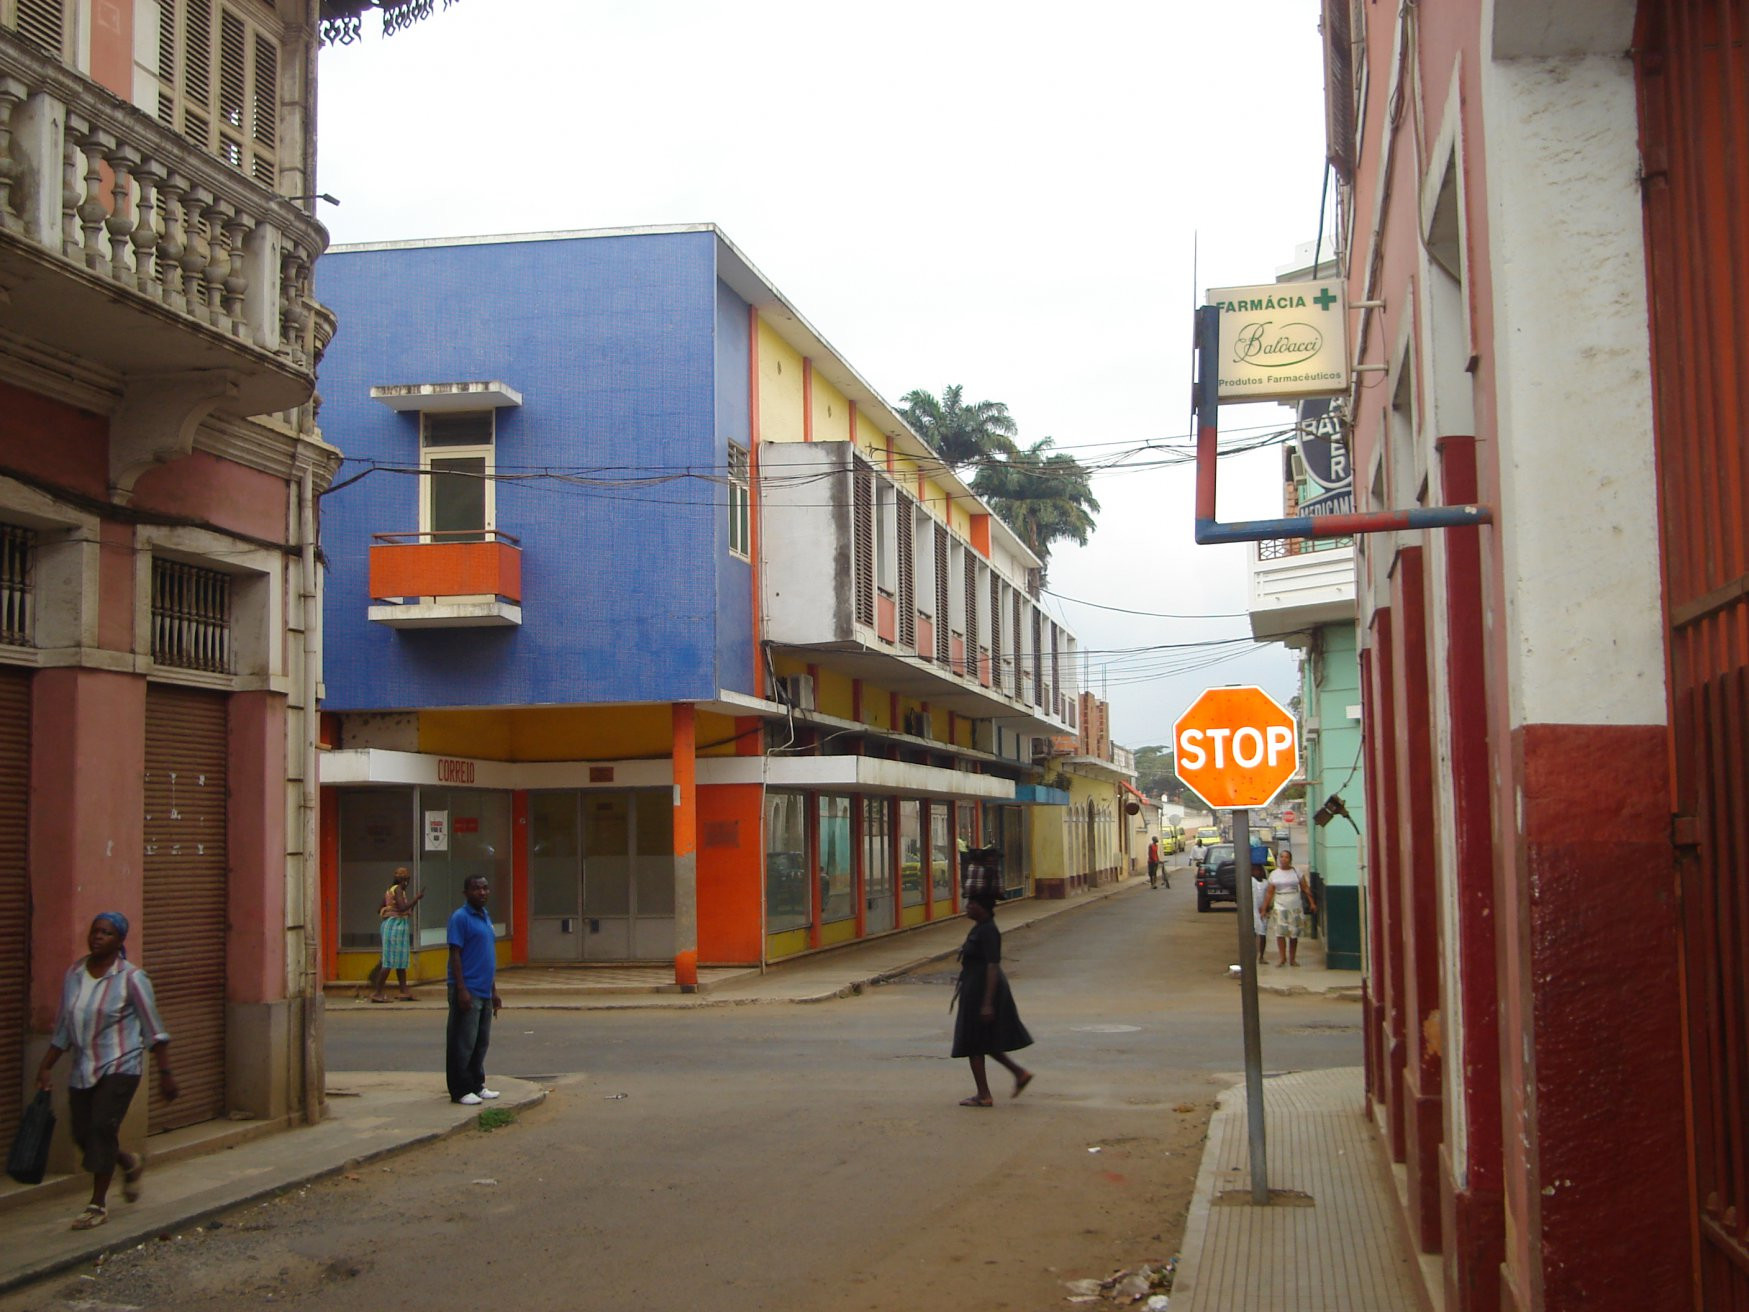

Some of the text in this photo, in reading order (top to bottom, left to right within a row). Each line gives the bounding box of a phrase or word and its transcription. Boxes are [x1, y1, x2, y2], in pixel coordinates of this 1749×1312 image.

[1216, 295, 1307, 313] FARMÁCIA
[1233, 321, 1320, 365] Baldacci
[1218, 377, 1263, 387] Produtos
[1180, 726, 1292, 770] STOP
[438, 759, 475, 784] CORREIO
